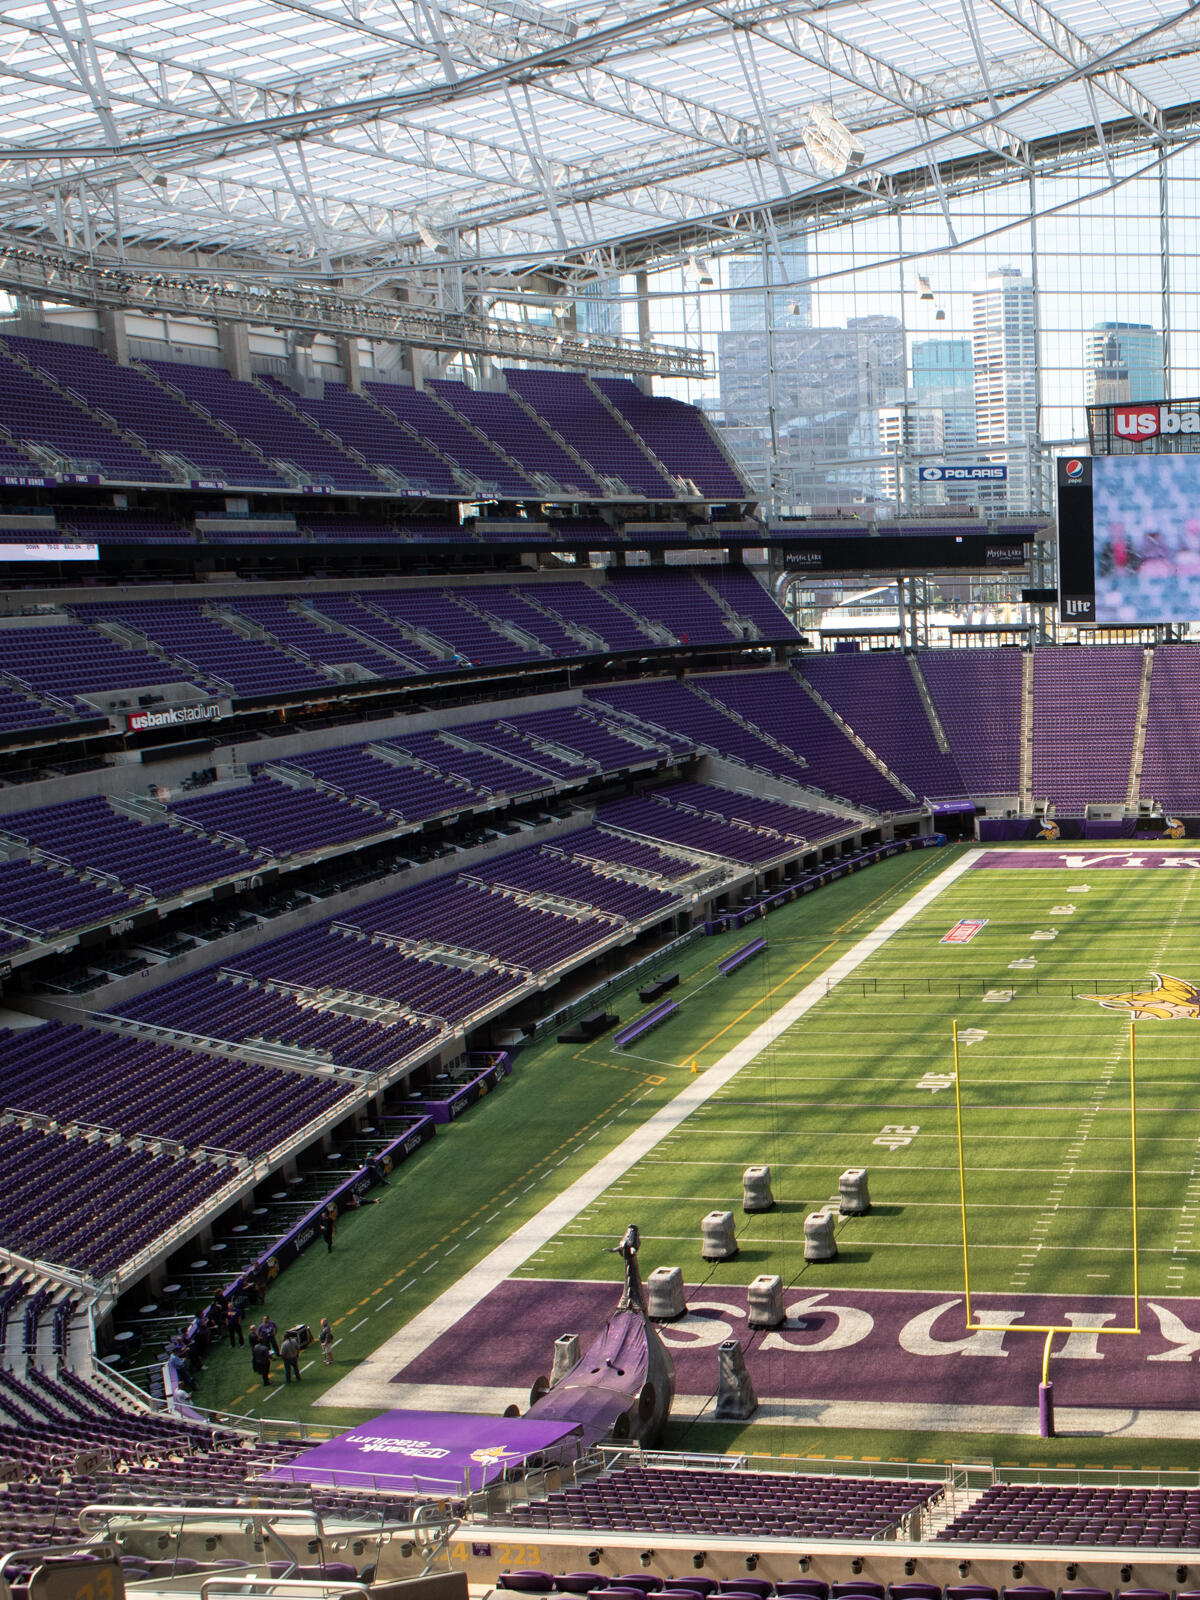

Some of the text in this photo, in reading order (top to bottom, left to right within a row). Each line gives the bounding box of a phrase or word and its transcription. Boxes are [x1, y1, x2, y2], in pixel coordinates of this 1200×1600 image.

[945, 468, 1004, 479] POLARIS
[1065, 599, 1091, 616] Lite
[345, 1434, 432, 1449] stadium
[497, 1544, 541, 1566] 223
